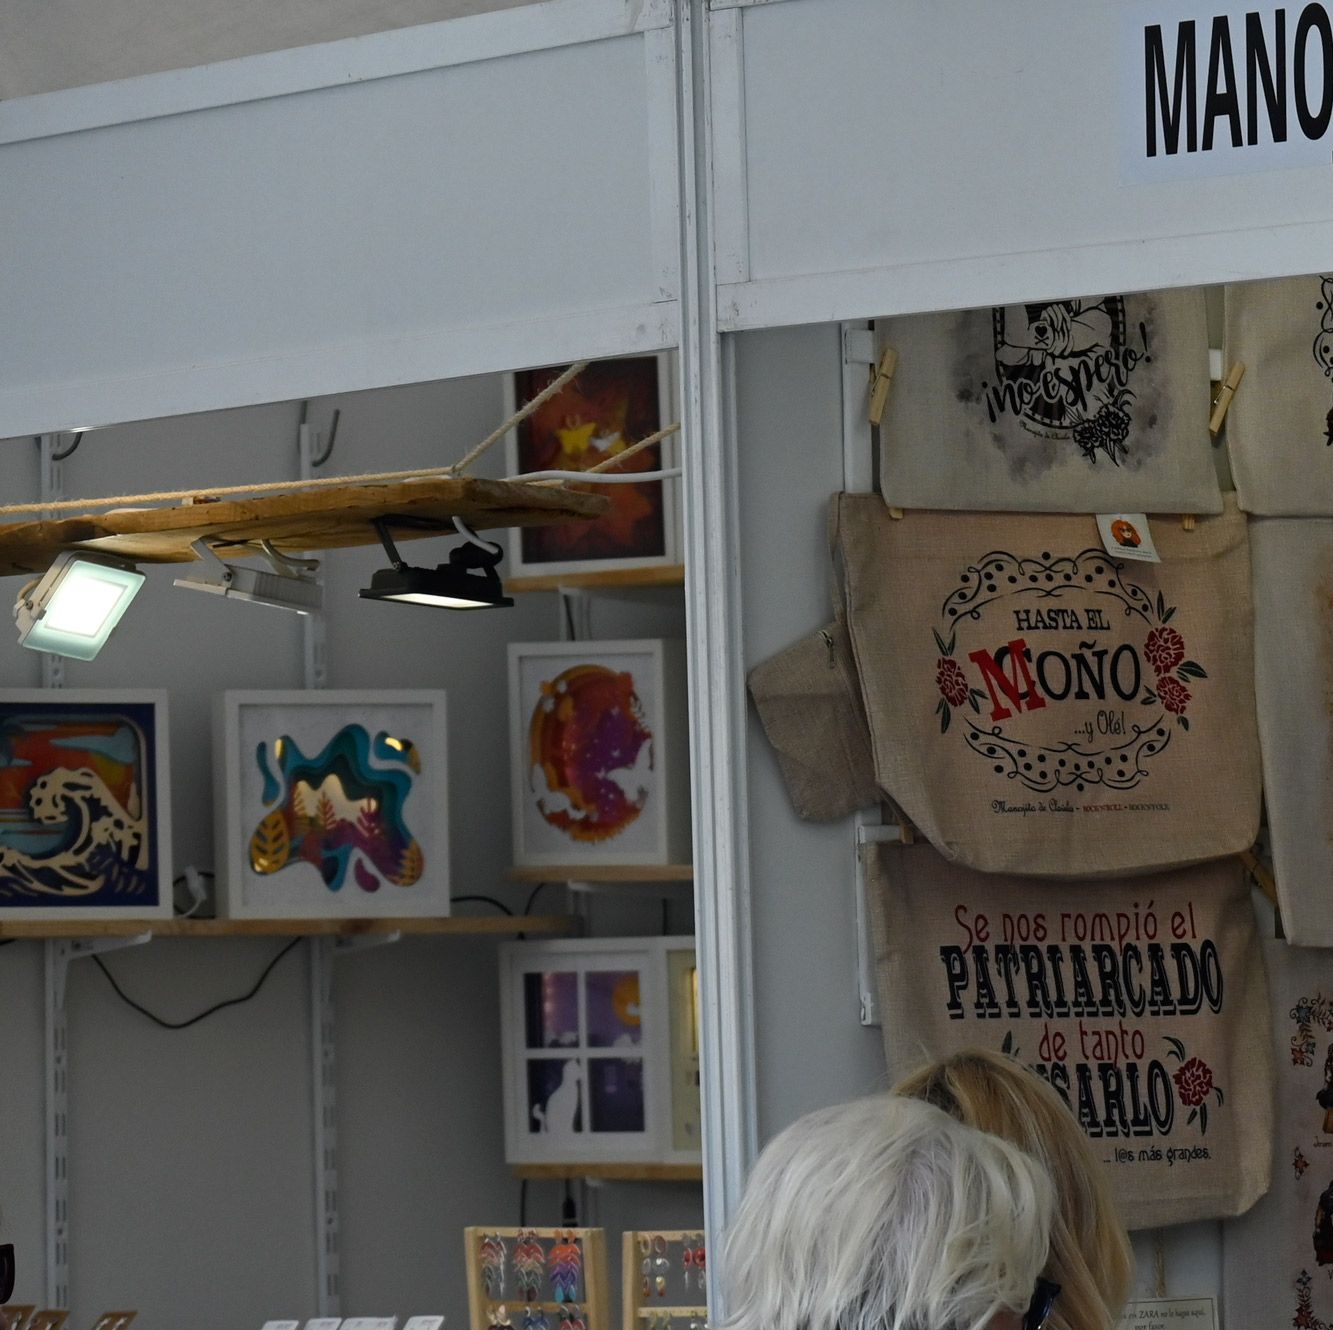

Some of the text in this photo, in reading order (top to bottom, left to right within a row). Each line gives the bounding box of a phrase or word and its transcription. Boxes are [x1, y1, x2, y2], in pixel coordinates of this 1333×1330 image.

[1013, 608, 1111, 631] HASTA EL
[968, 638, 1142, 722] MOÑO
[1097, 710, 1126, 735] Olé!
[955, 900, 1197, 956] Se nos rompió el
[939, 939, 1224, 1019] PATRIARCADO
[1039, 1019, 1145, 1066] de tanto
[1139, 1309, 1159, 1319] ZARA
